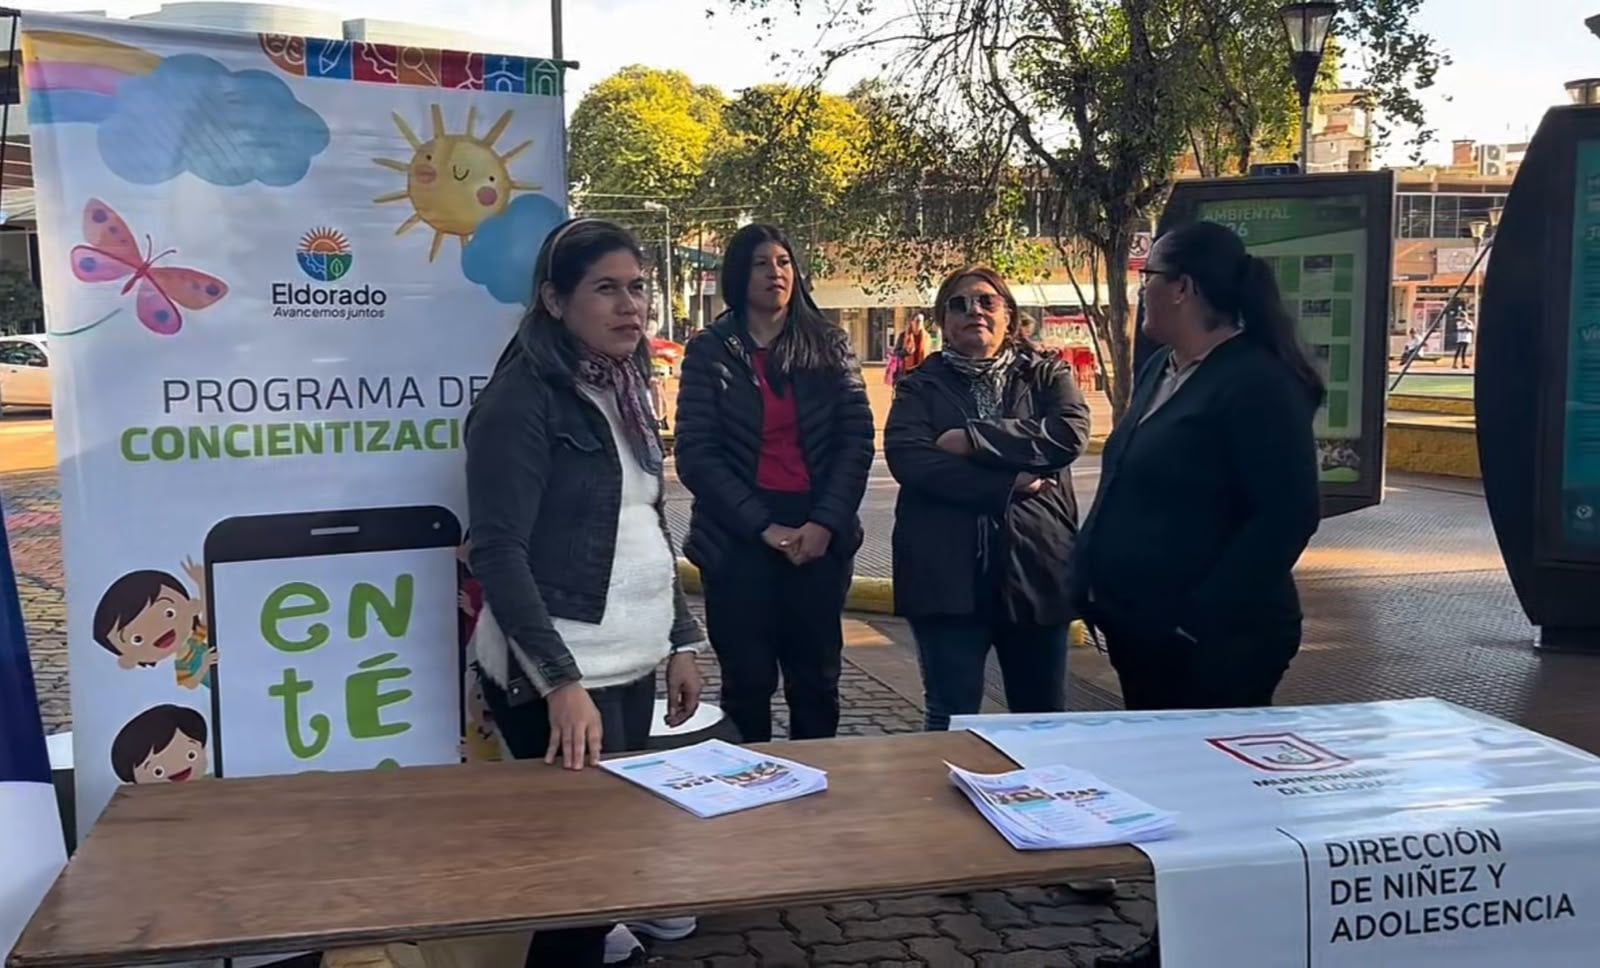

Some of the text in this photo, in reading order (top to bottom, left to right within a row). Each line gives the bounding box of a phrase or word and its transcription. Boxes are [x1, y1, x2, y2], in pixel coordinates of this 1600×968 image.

[1202, 207, 1291, 222] AMBIENTAL
[271, 282, 387, 306] Eldorado
[273, 306, 385, 320] Avancemos juntos
[162, 375, 489, 413] PROGRAMA DE
[119, 417, 460, 462] CONCIENTIZACI
[1278, 787, 1309, 796] DE
[1309, 777, 1408, 793] ELDORA
[1325, 827, 1502, 868] DIRECCIÓN
[1330, 862, 1507, 905] DE NIÑEZ Y
[1329, 893, 1576, 943] ADOLESCENCIA
